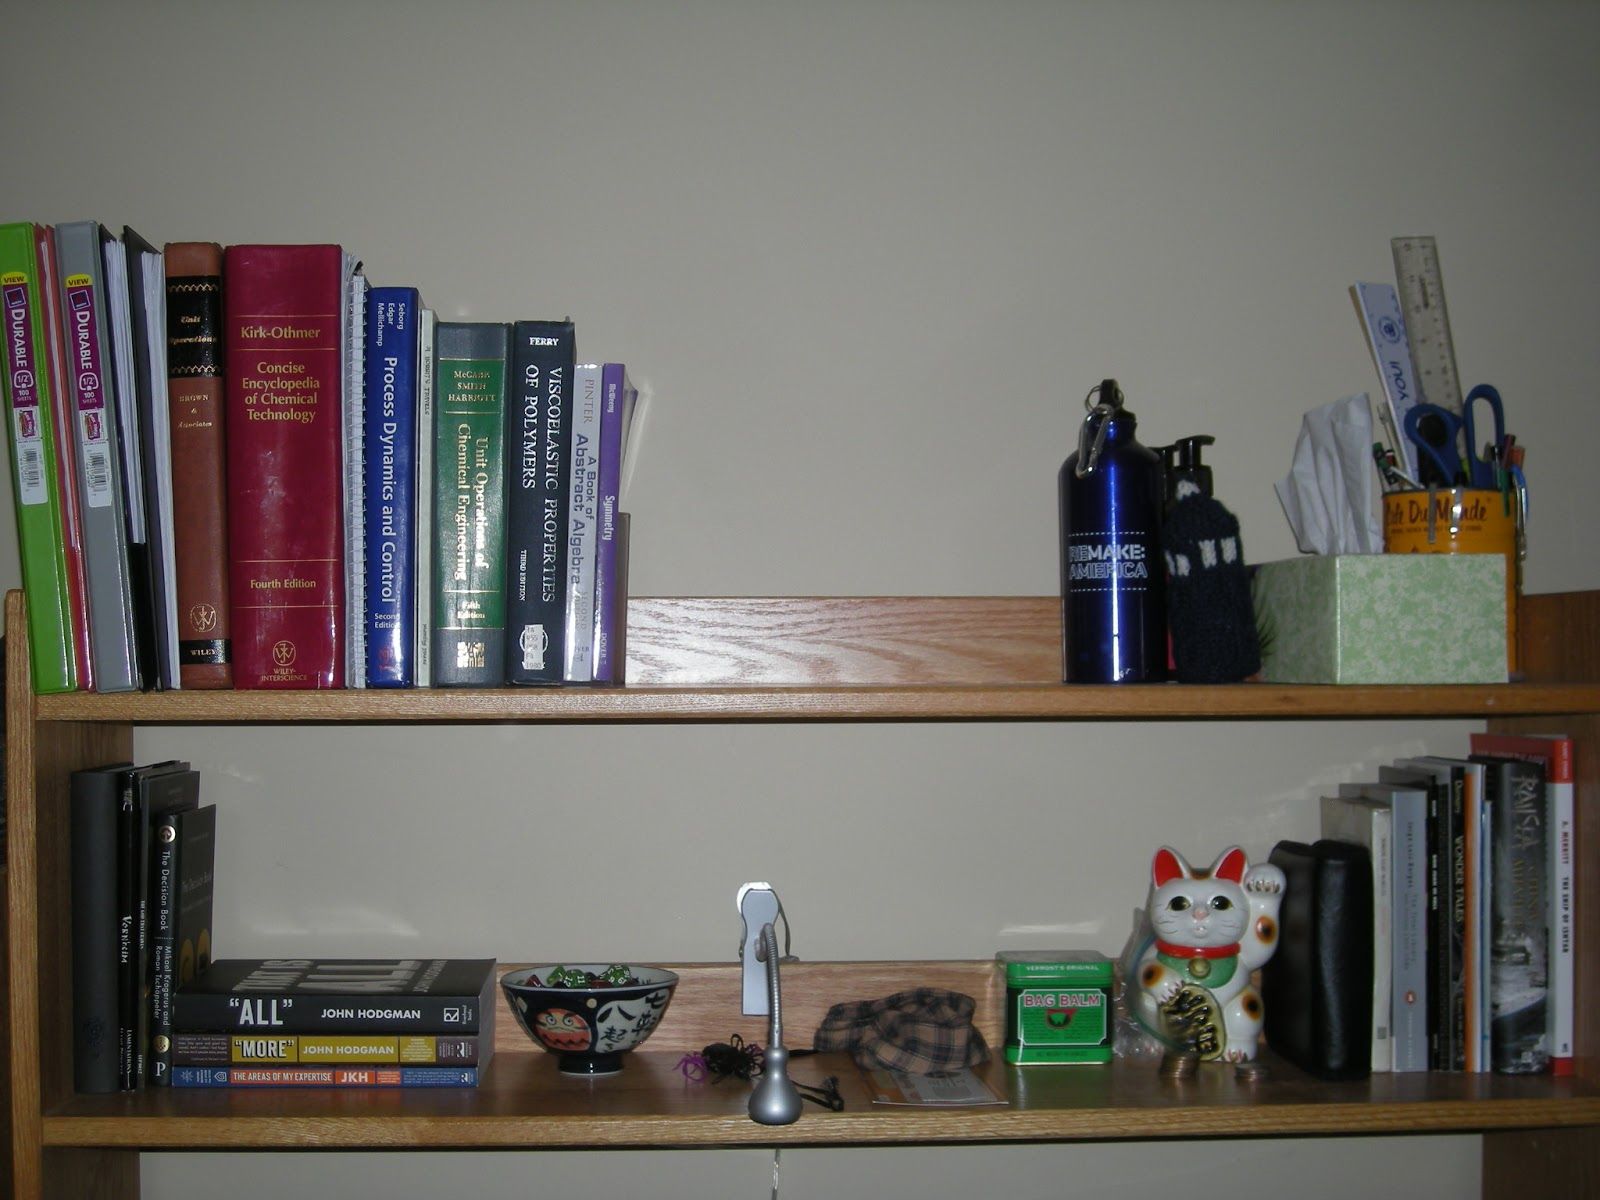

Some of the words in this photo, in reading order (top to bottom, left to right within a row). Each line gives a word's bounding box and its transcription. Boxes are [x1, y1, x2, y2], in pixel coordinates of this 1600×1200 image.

[4, 276, 24, 284] VIEW
[68, 278, 89, 286] VIEW
[376, 302, 384, 347] Mellichamp
[387, 301, 395, 326] Edgar
[397, 302, 406, 331] Seborg
[11, 308, 27, 367] DURABLE
[76, 310, 92, 370] DURABLE
[240, 325, 320, 341] Kirk-Othmer
[528, 336, 560, 347] FERRY
[256, 361, 305, 374] Concise
[525, 364, 541, 388] OF
[242, 376, 320, 392] Encyclopedia
[383, 356, 399, 417] Process
[179, 394, 208, 402] BROWN
[244, 391, 257, 405] of
[259, 391, 318, 405] Chemical
[583, 378, 596, 424] PINTER
[606, 383, 617, 414] McWeeny
[246, 408, 316, 423] Technology
[545, 366, 563, 490] VISCOELASTIC
[476, 436, 490, 469] Unit
[521, 395, 539, 490] POLYMERS
[381, 421, 397, 502] Dynamics
[457, 422, 472, 491] Chemical
[586, 455, 597, 466] A
[572, 433, 589, 512] Abstract
[585, 470, 596, 502] Book
[381, 505, 396, 537] and
[474, 472, 492, 547] Operations
[586, 506, 595, 521] of
[601, 494, 616, 542] Symmetry
[1436, 496, 1488, 522] Mnde
[454, 495, 471, 582] Engineering
[541, 498, 559, 602] PROPERTIES
[475, 549, 490, 569] of
[570, 518, 586, 586] Algebra
[250, 578, 282, 590] Fourth
[283, 577, 317, 590] Edition
[380, 541, 397, 603] Control
[1069, 561, 1149, 580] AMERICA
[374, 612, 400, 621] Second
[162, 850, 171, 866] The
[1454, 835, 1464, 887] WONDER
[160, 868, 169, 906] Decision
[1455, 888, 1464, 923] TALES
[159, 909, 168, 932] Book
[1562, 914, 1569, 924] OF
[164, 945, 172, 972] Mikael
[163, 974, 171, 1008] Krogerus
[1023, 994, 1055, 1007] BAG
[1058, 993, 1101, 1007] BALM
[162, 1011, 170, 1026] and
[321, 1008, 355, 1020] JOHN
[357, 1008, 421, 1020] HODGMAN
[303, 1045, 334, 1055] JOHN
[336, 1045, 395, 1055] HODGMAN
[154, 1062, 166, 1077] P
[233, 1071, 245, 1082] THE
[246, 1071, 271, 1082] AREAS
[272, 1071, 282, 1082] OF
[282, 1071, 294, 1082] MY
[294, 1071, 333, 1083] EXPERTISE
[341, 1071, 369, 1083] JKH
